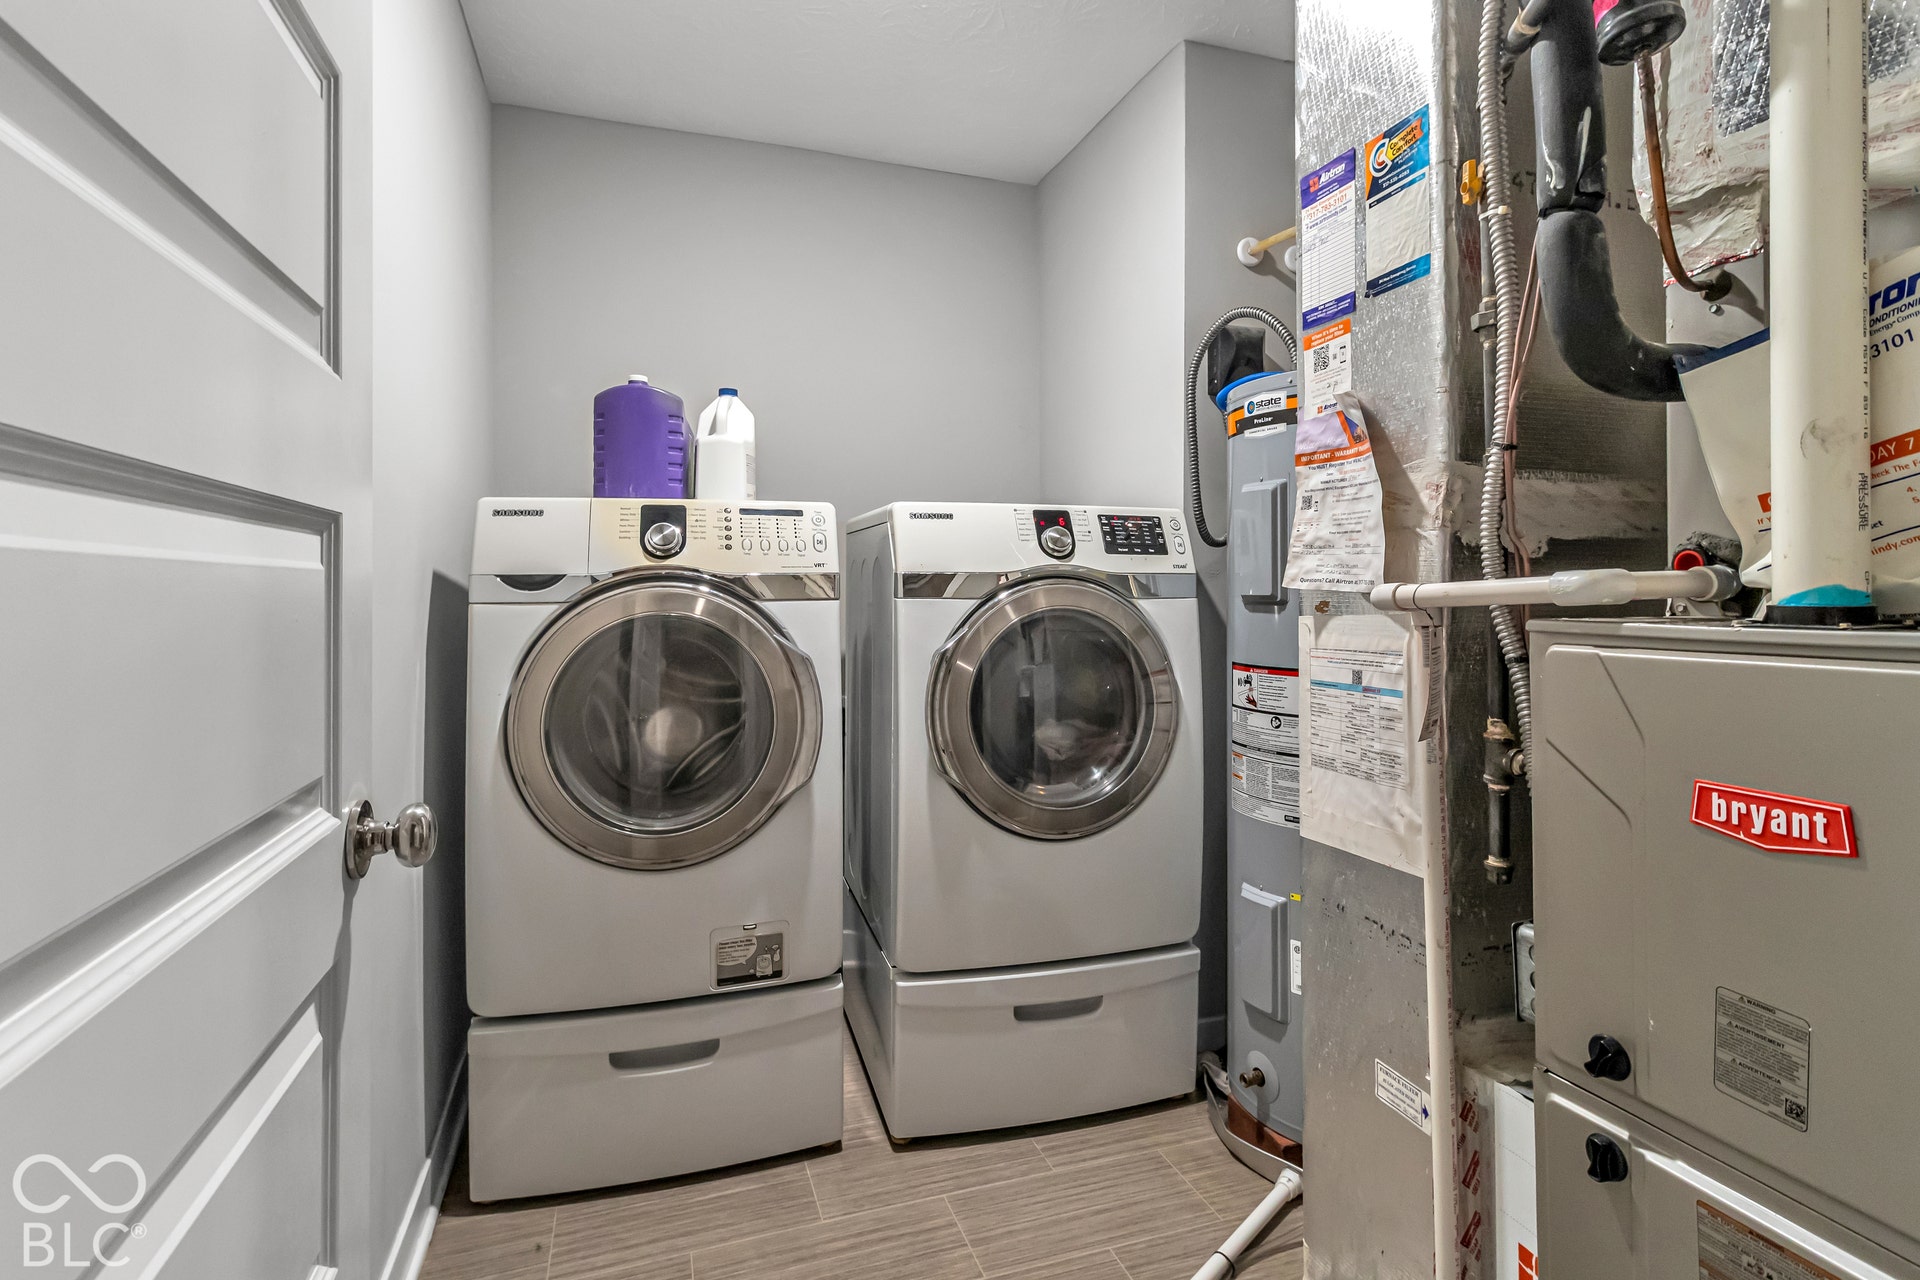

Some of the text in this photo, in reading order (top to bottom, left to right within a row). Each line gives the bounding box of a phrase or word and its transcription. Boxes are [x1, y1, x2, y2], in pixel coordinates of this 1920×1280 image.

[1390, 125, 1418, 150] Complete
[1392, 133, 1417, 157] Comfort
[1320, 163, 1346, 184] Airtron
[1896, 310, 1920, 324] Comp
[1870, 328, 1914, 358] 3101
[1256, 397, 1281, 408] state
[1904, 437, 1914, 450] 7
[1301, 452, 1331, 462] IMPORTANT
[1893, 462, 1910, 473] The
[492, 508, 544, 517] SAMSUNG
[1712, 792, 1828, 844] bryant
[1747, 1000, 1776, 1014] WARNING
[1734, 1024, 1785, 1049] AVERTISSEMENT
[1380, 1067, 1419, 1097] FURNACE FILTER
[1739, 1062, 1781, 1084] ADVERTENCIA
